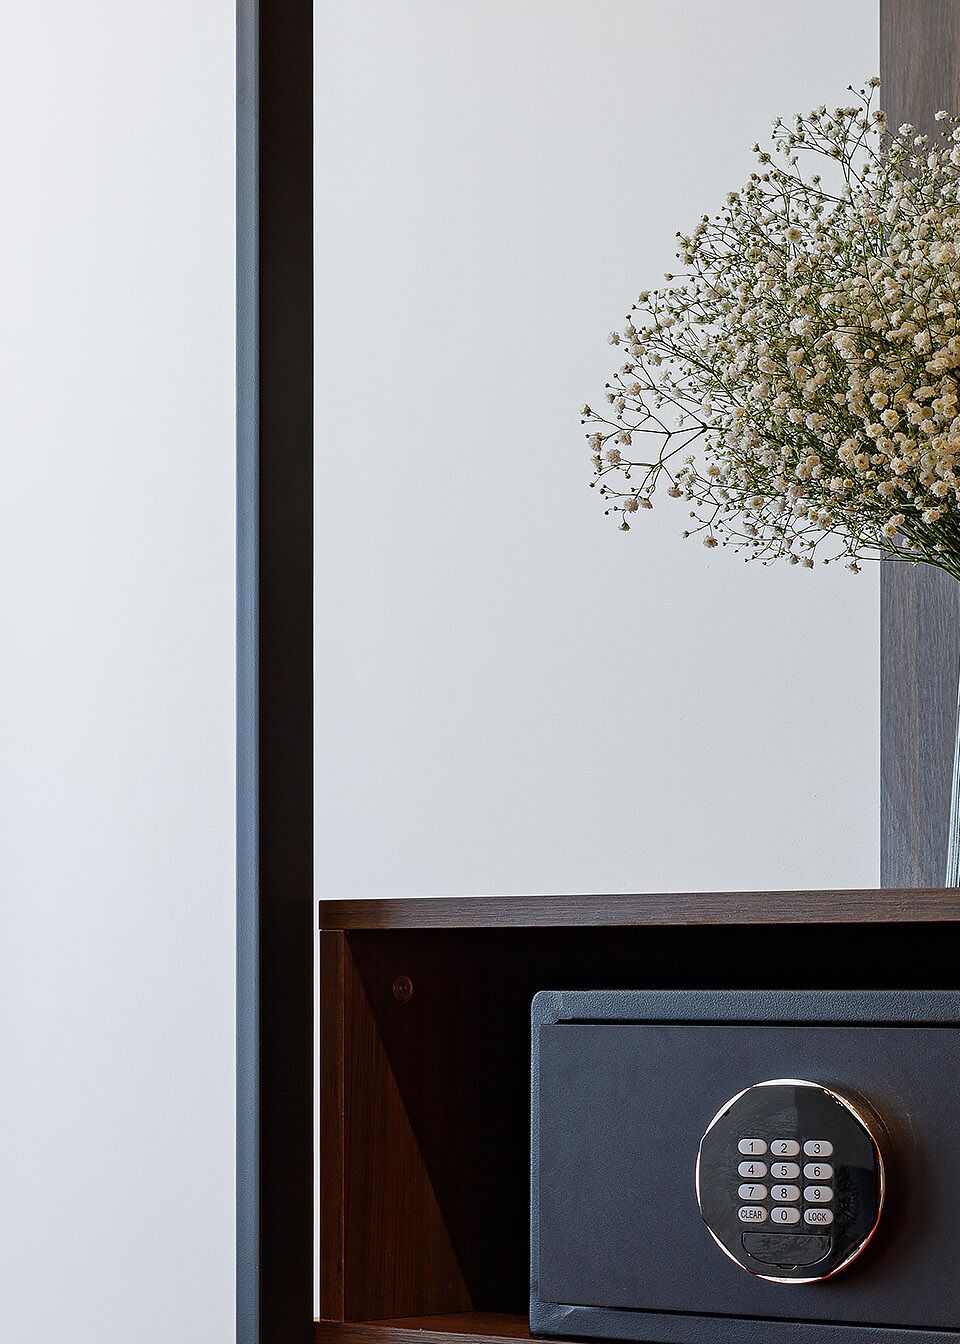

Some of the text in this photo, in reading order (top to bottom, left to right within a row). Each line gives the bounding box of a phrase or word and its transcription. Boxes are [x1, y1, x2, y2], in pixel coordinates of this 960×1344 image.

[748, 1142, 754, 1152] 1
[780, 1143, 787, 1153] 2
[814, 1144, 820, 1154] 3
[748, 1165, 754, 1174] 4
[780, 1166, 787, 1176] 5
[814, 1166, 820, 1176] 6
[748, 1187, 754, 1197] 7
[780, 1188, 787, 1198] 8
[814, 1189, 820, 1199] 9
[741, 1210, 762, 1219] CLEAR
[781, 1210, 787, 1220] 0
[808, 1212, 826, 1222] LOCK
